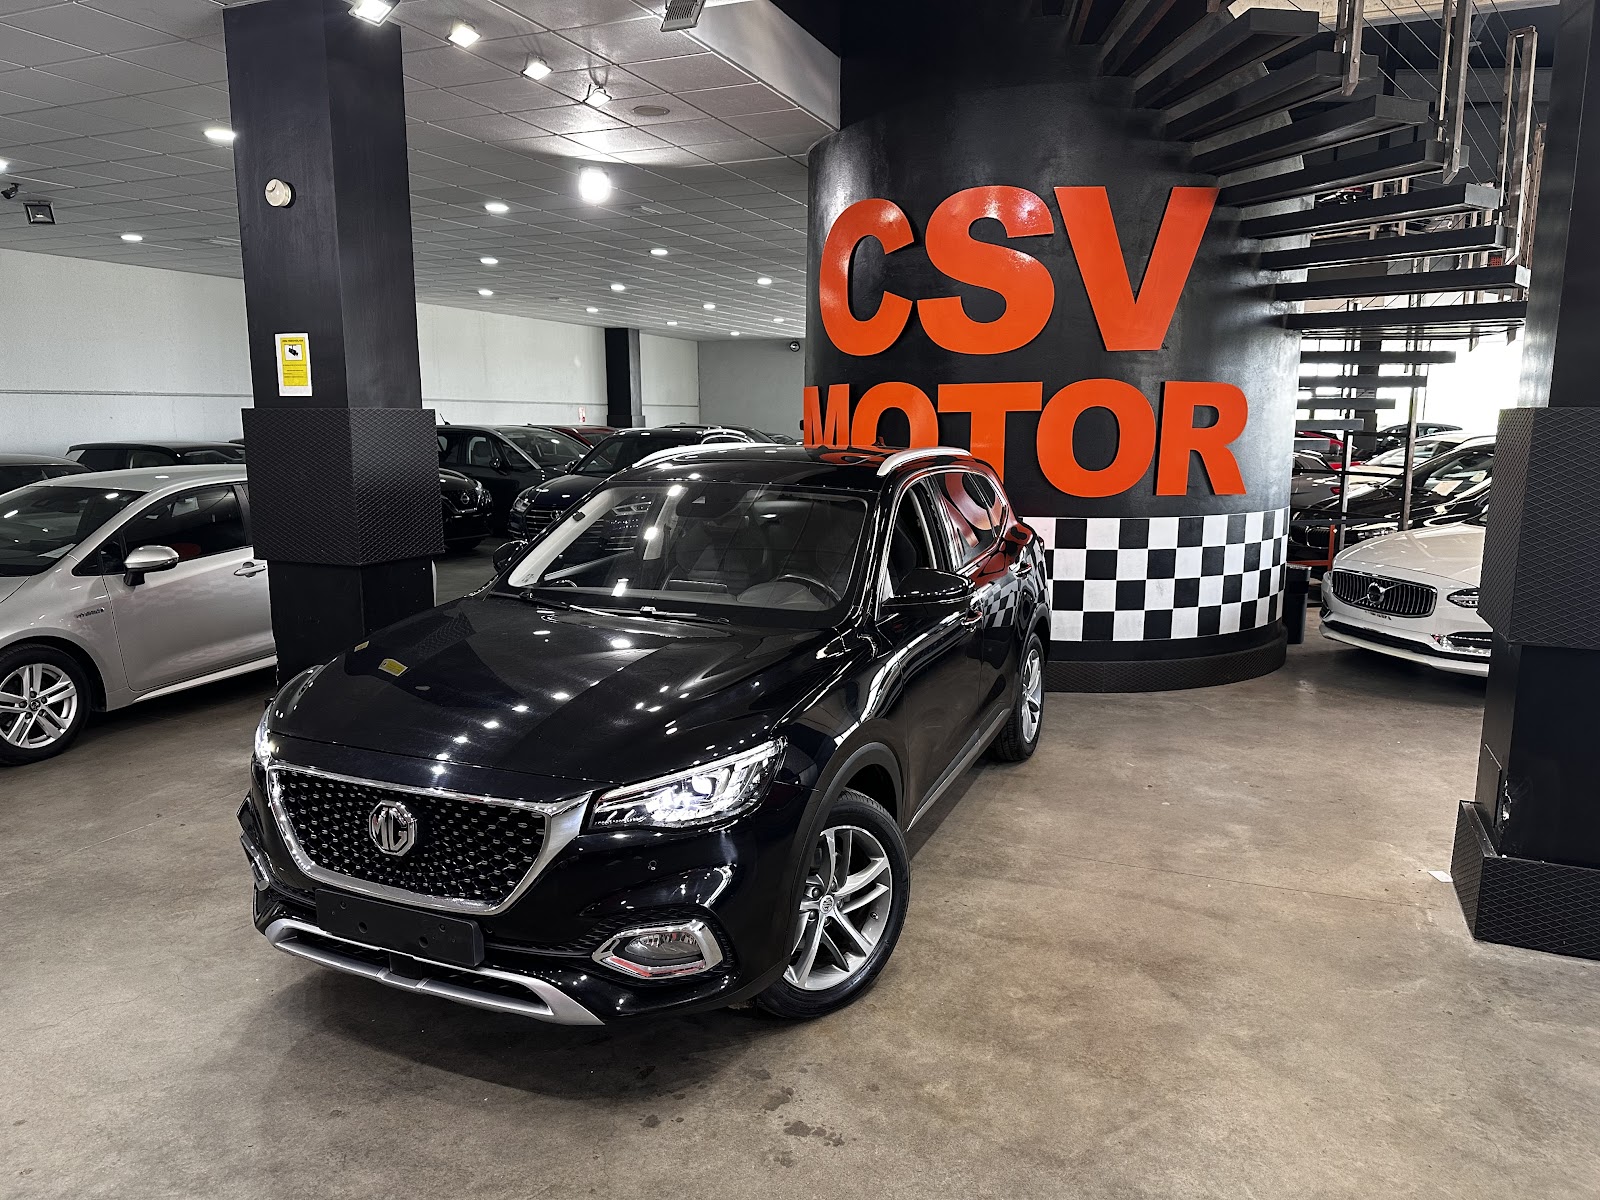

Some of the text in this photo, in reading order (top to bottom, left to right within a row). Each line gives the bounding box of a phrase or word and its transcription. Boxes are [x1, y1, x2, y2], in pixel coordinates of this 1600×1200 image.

[819, 185, 1220, 356] CSV
[803, 378, 1248, 498] MOTOR
[371, 804, 409, 853] MG
